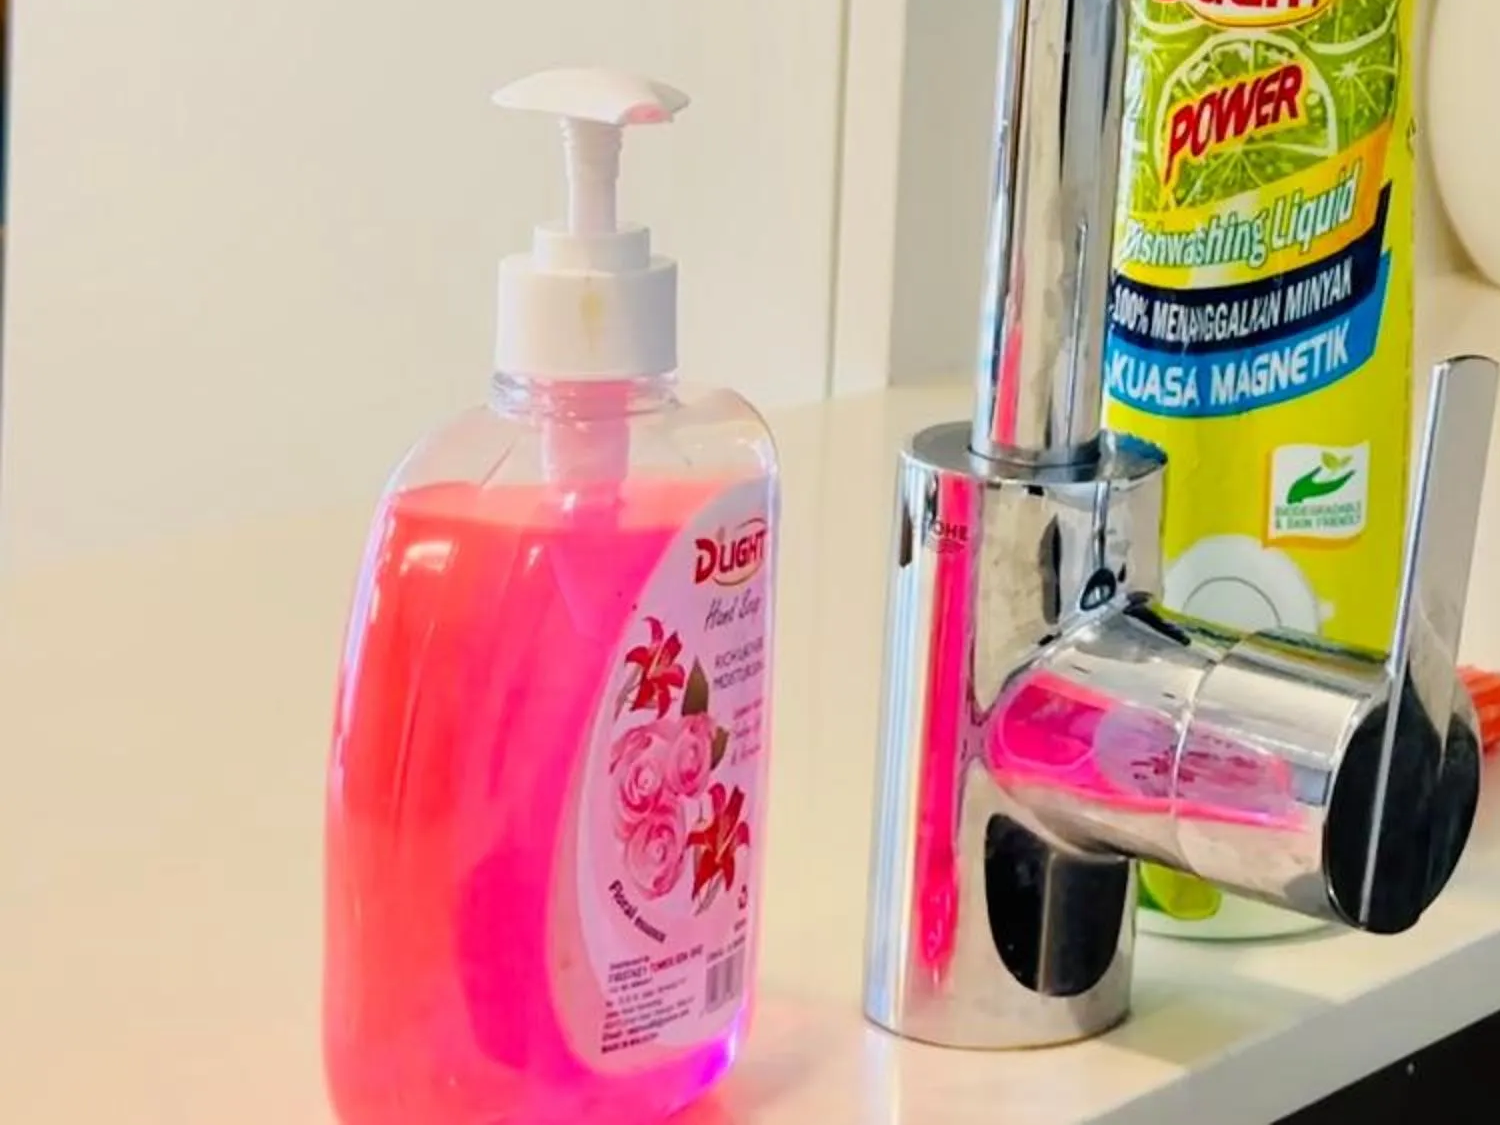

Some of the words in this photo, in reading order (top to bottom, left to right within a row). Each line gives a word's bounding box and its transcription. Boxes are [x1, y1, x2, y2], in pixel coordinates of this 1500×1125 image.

[1164, 63, 1303, 186] POWER
[1272, 159, 1361, 253] Liquid
[1112, 286, 1149, 335] 100%
[1283, 257, 1353, 323] MINYAK
[1110, 350, 1200, 408] KUASA
[1210, 320, 1350, 405] MAGNETIK
